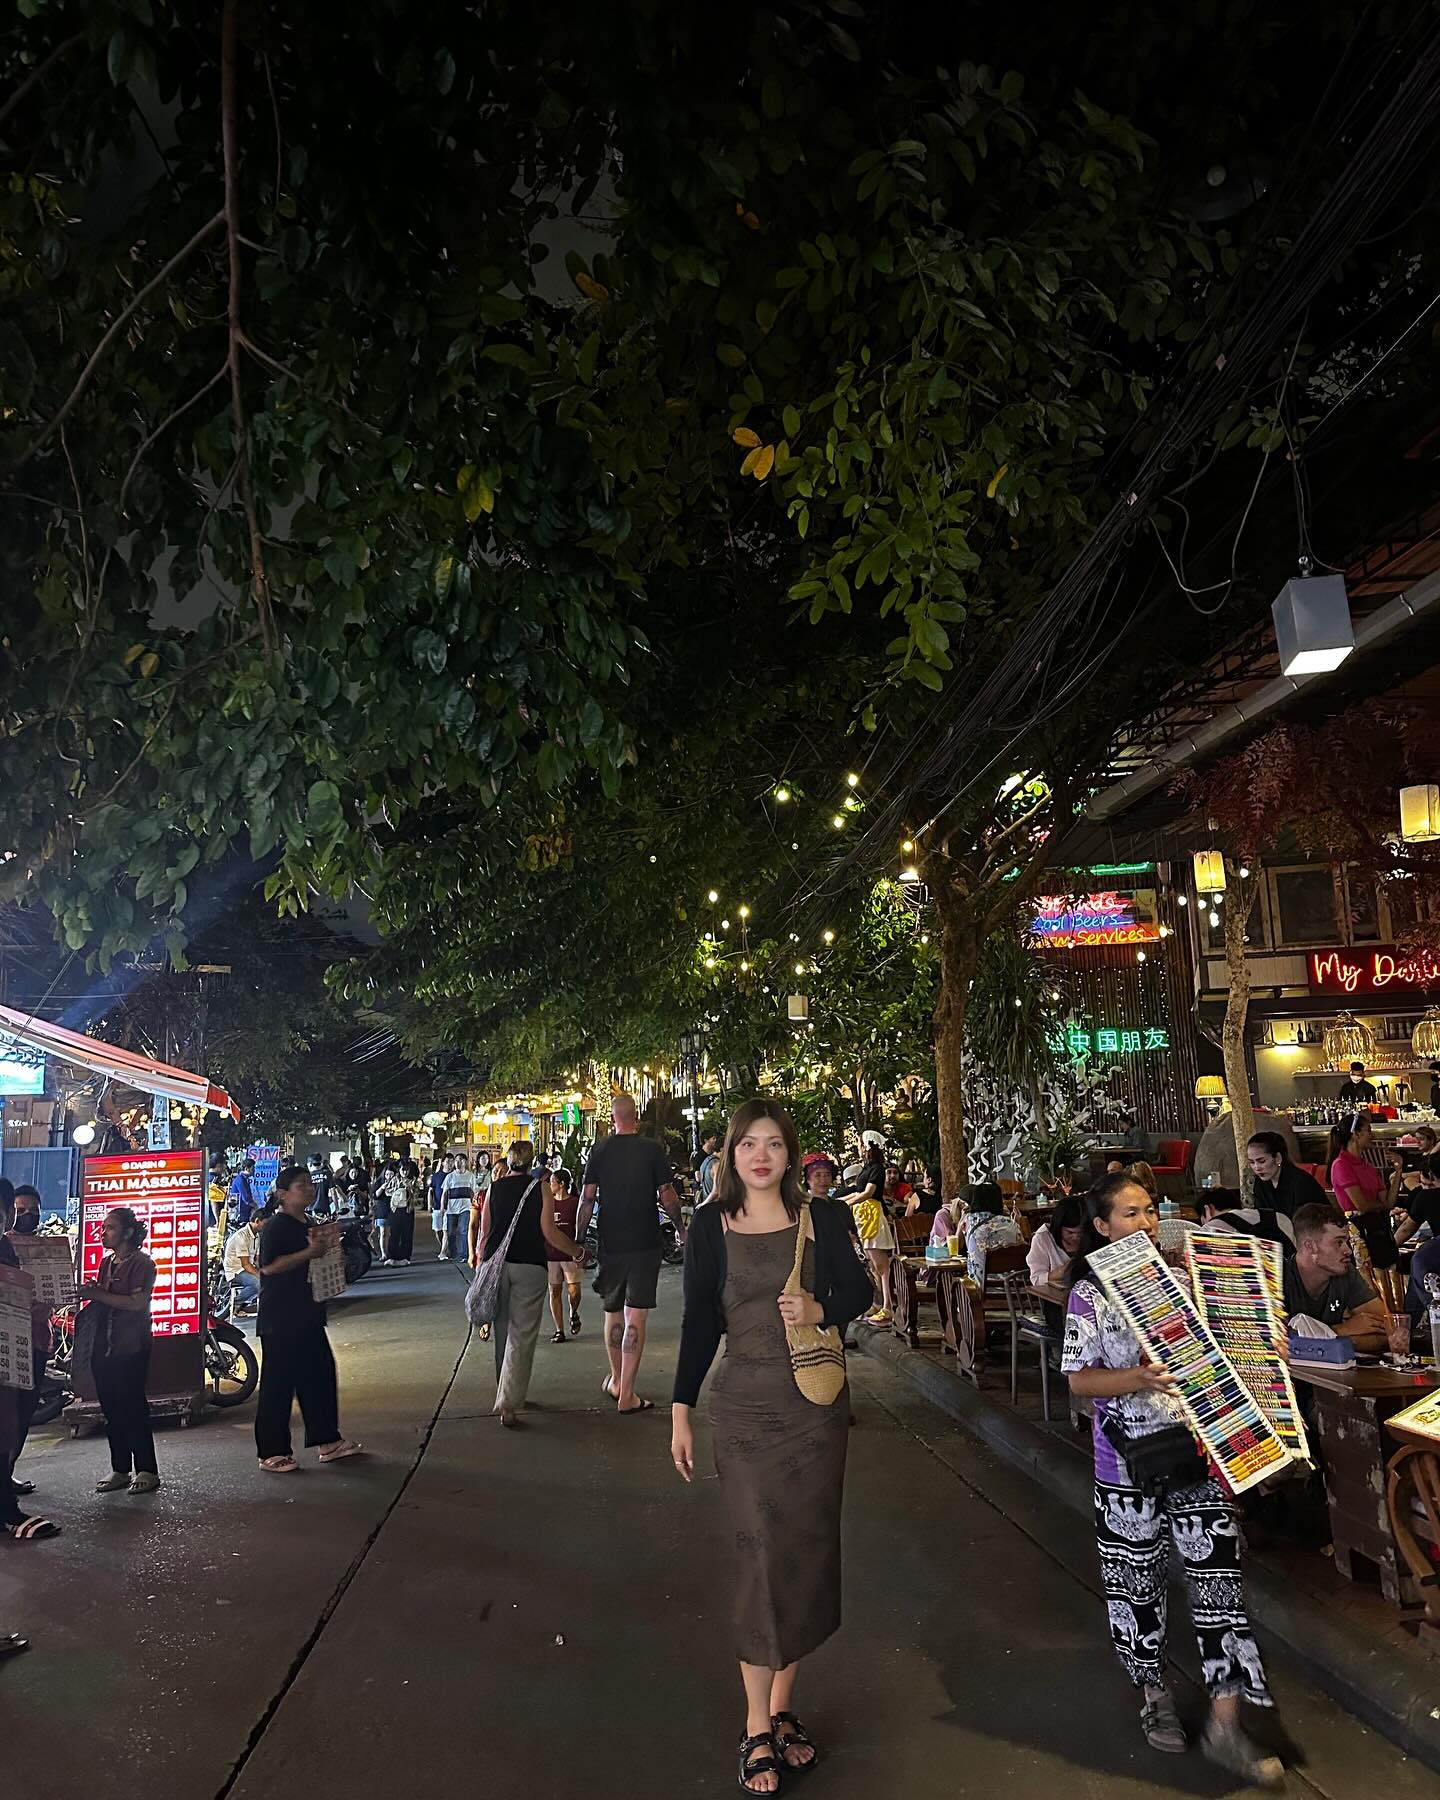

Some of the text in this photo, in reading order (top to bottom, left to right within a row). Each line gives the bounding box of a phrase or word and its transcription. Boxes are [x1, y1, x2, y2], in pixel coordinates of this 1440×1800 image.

[1072, 913, 1120, 928] Beers
[1078, 928, 1146, 945] Services
[1314, 952, 1362, 992] My
[248, 1148, 279, 1160] SIM
[88, 1175, 200, 1192] THAI MASSAGE
[177, 1219, 198, 1232] 200
[89, 1253, 96, 1265] 1
